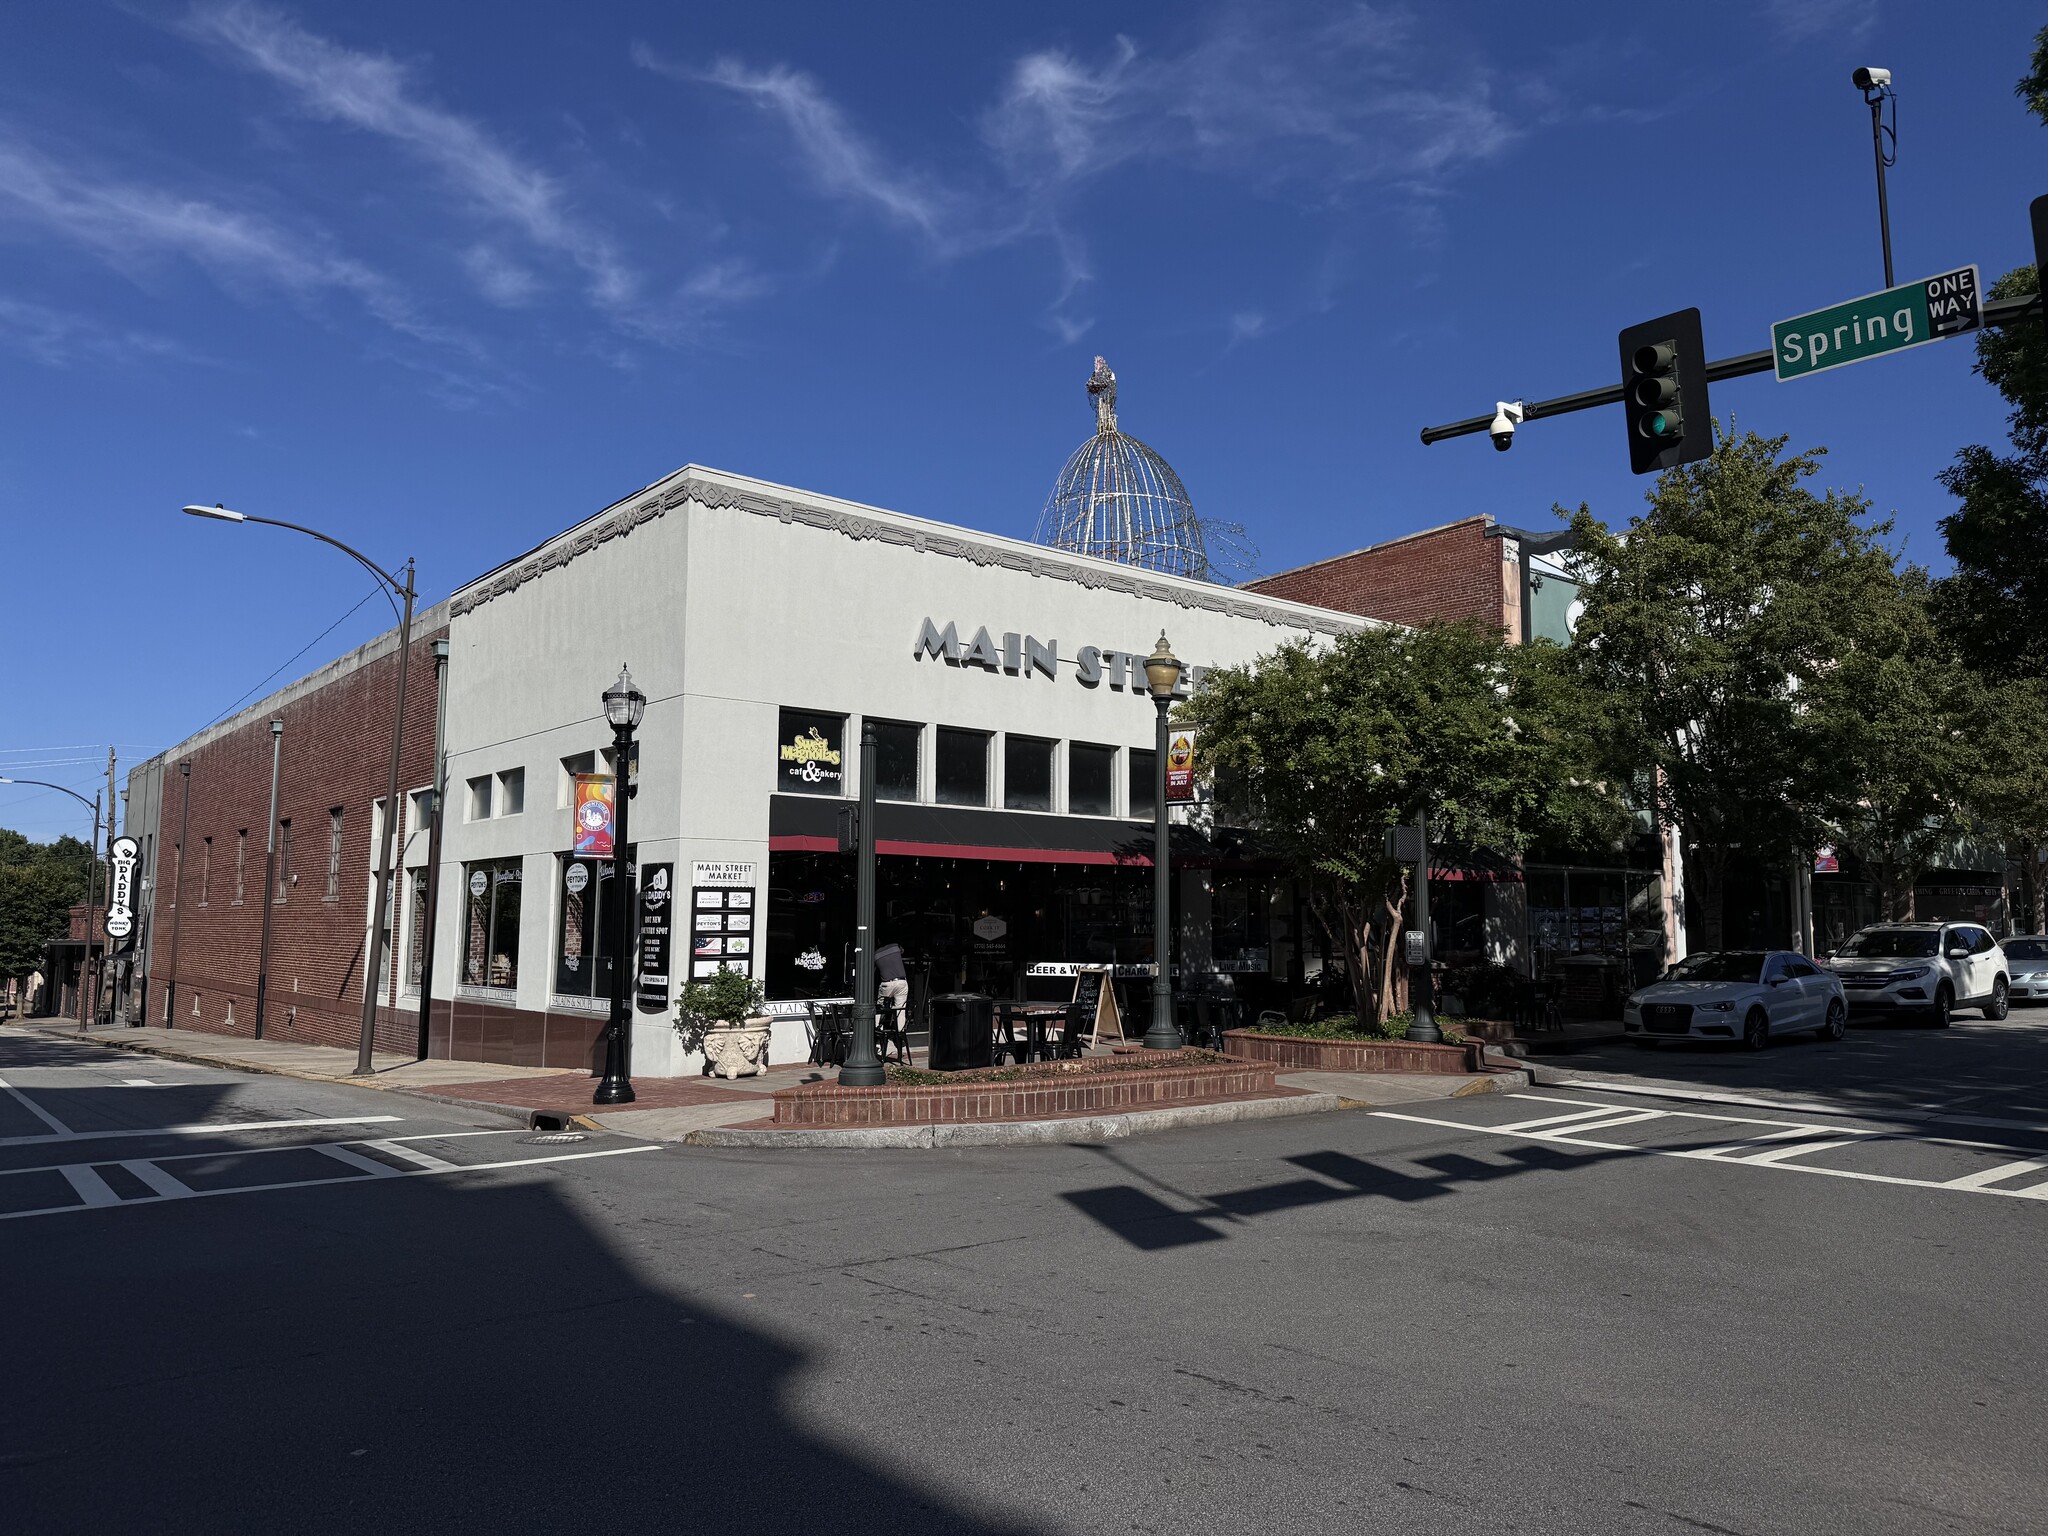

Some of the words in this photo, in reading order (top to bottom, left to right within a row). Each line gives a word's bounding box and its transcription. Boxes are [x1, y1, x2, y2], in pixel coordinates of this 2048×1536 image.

[1928, 271, 1972, 298] ONE
[1929, 291, 1975, 319] WAY
[1783, 307, 1914, 367] Spring
[914, 616, 1058, 682] MAIN
[1075, 645, 1210, 698] STRE
[802, 761, 821, 782] &
[708, 872, 742, 880] MARKET
[725, 864, 752, 872] STREET
[1027, 963, 1056, 974] BEER
[1059, 966, 1067, 974] &
